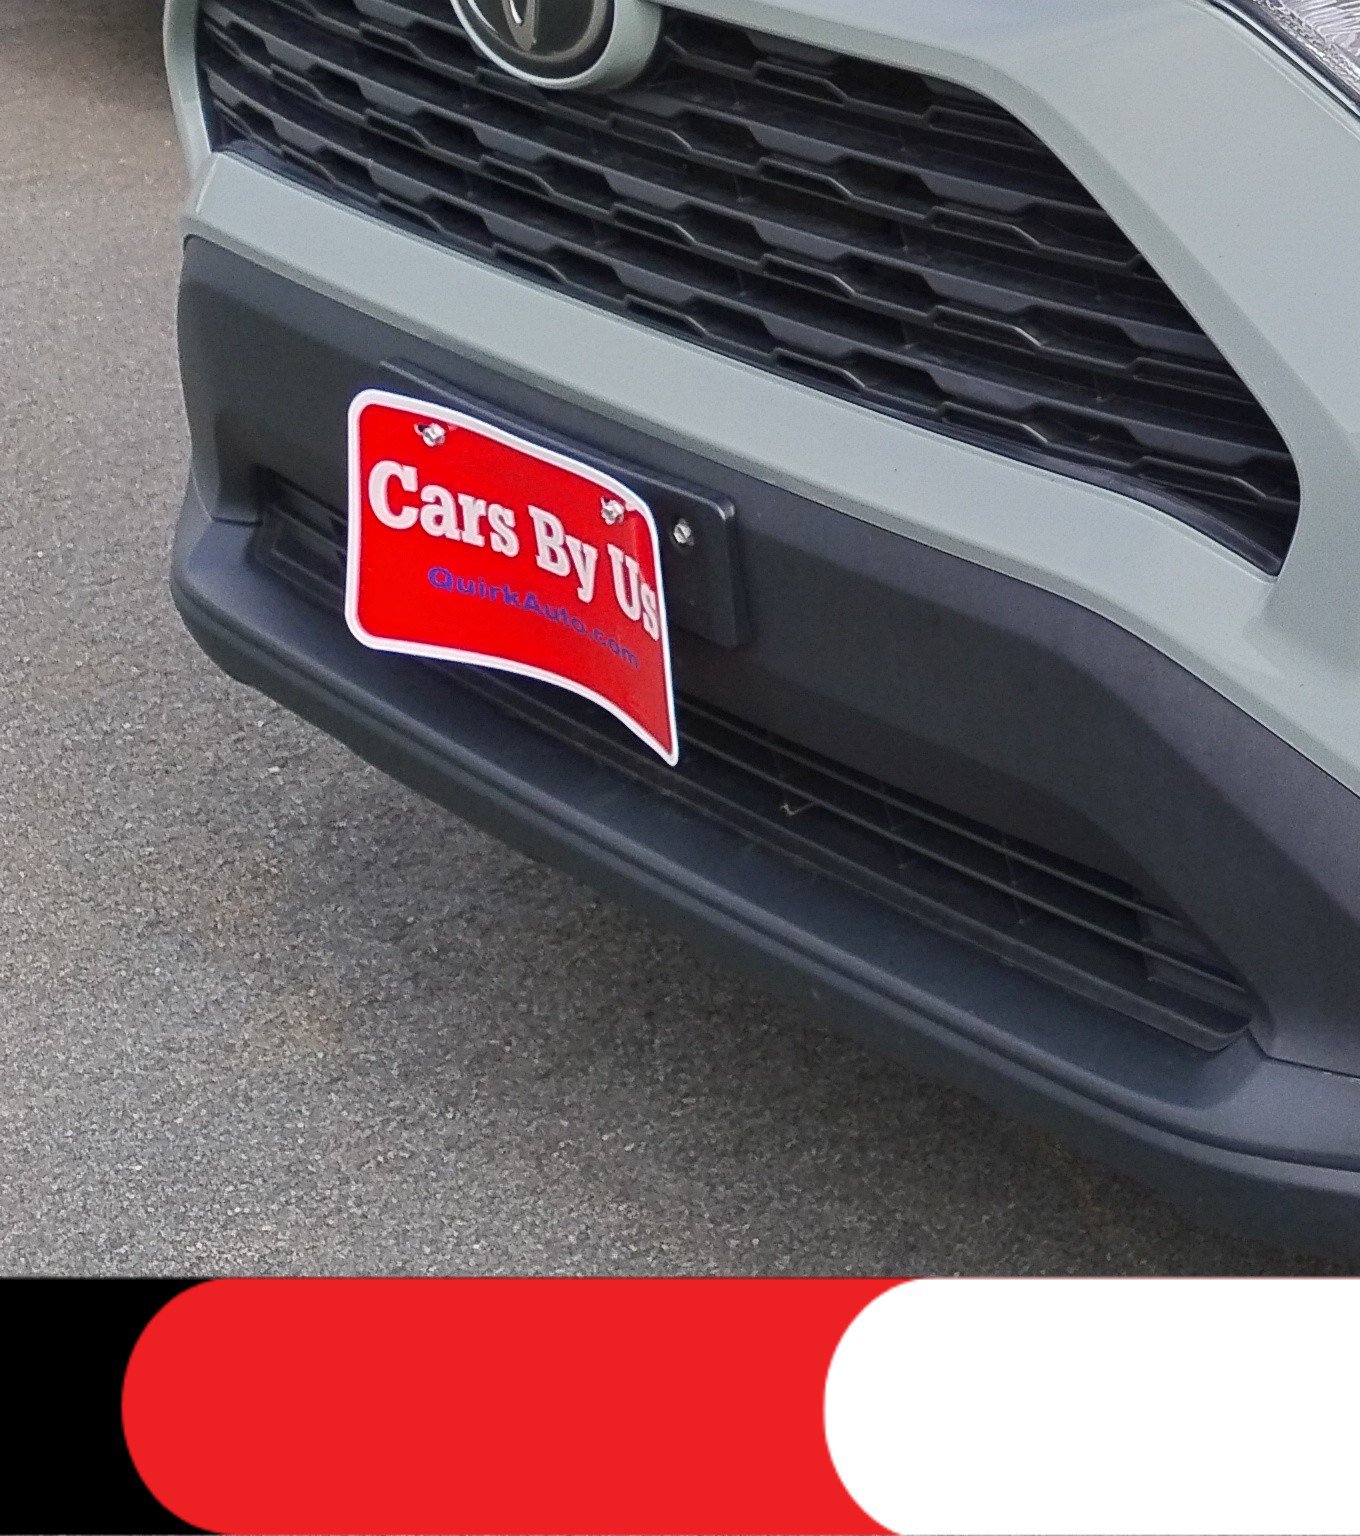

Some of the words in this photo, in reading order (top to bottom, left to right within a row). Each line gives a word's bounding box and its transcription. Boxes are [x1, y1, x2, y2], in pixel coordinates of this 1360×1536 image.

[367, 460, 520, 558] Cars
[528, 504, 598, 604] By
[608, 544, 661, 642] Us
[427, 566, 641, 670] QuirkAuto.com
